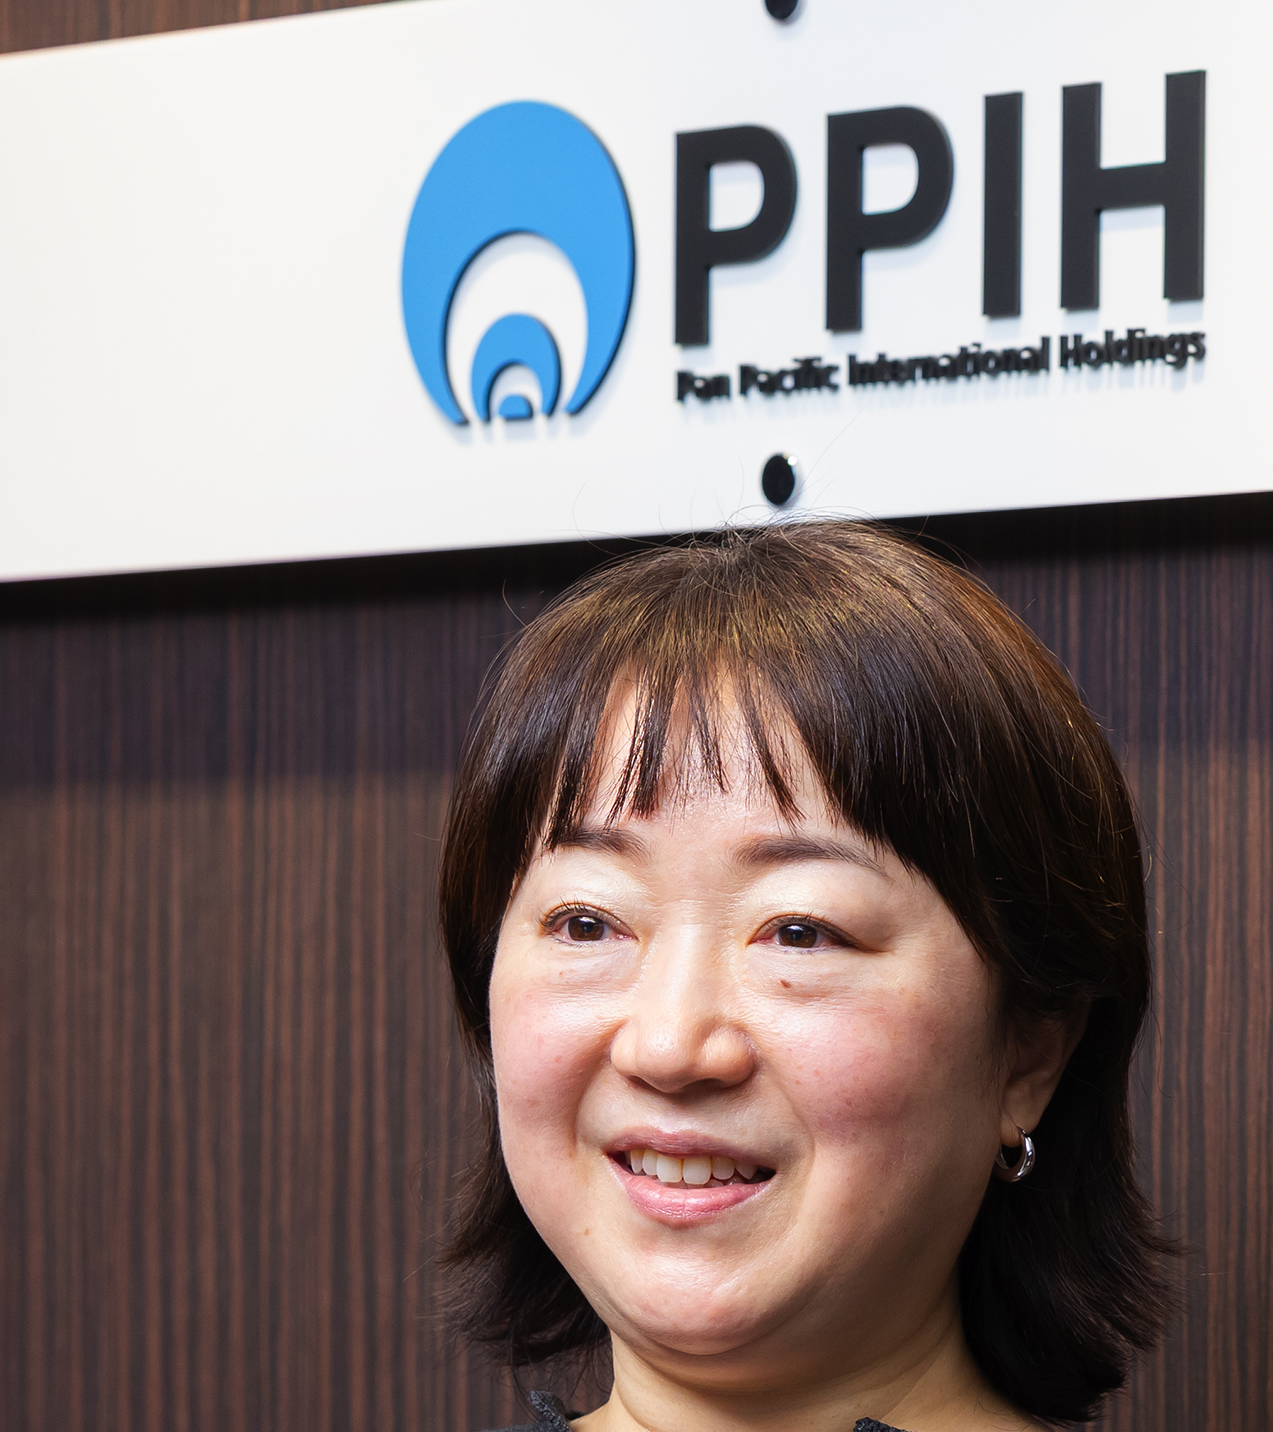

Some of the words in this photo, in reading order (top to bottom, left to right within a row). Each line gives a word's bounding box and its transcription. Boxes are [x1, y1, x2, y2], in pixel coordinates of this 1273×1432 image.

[675, 70, 1206, 345] PPIH
[676, 371, 731, 402] Pan
[739, 357, 840, 396] Pacific
[848, 336, 1050, 386] International
[1059, 328, 1206, 369] Holdings
